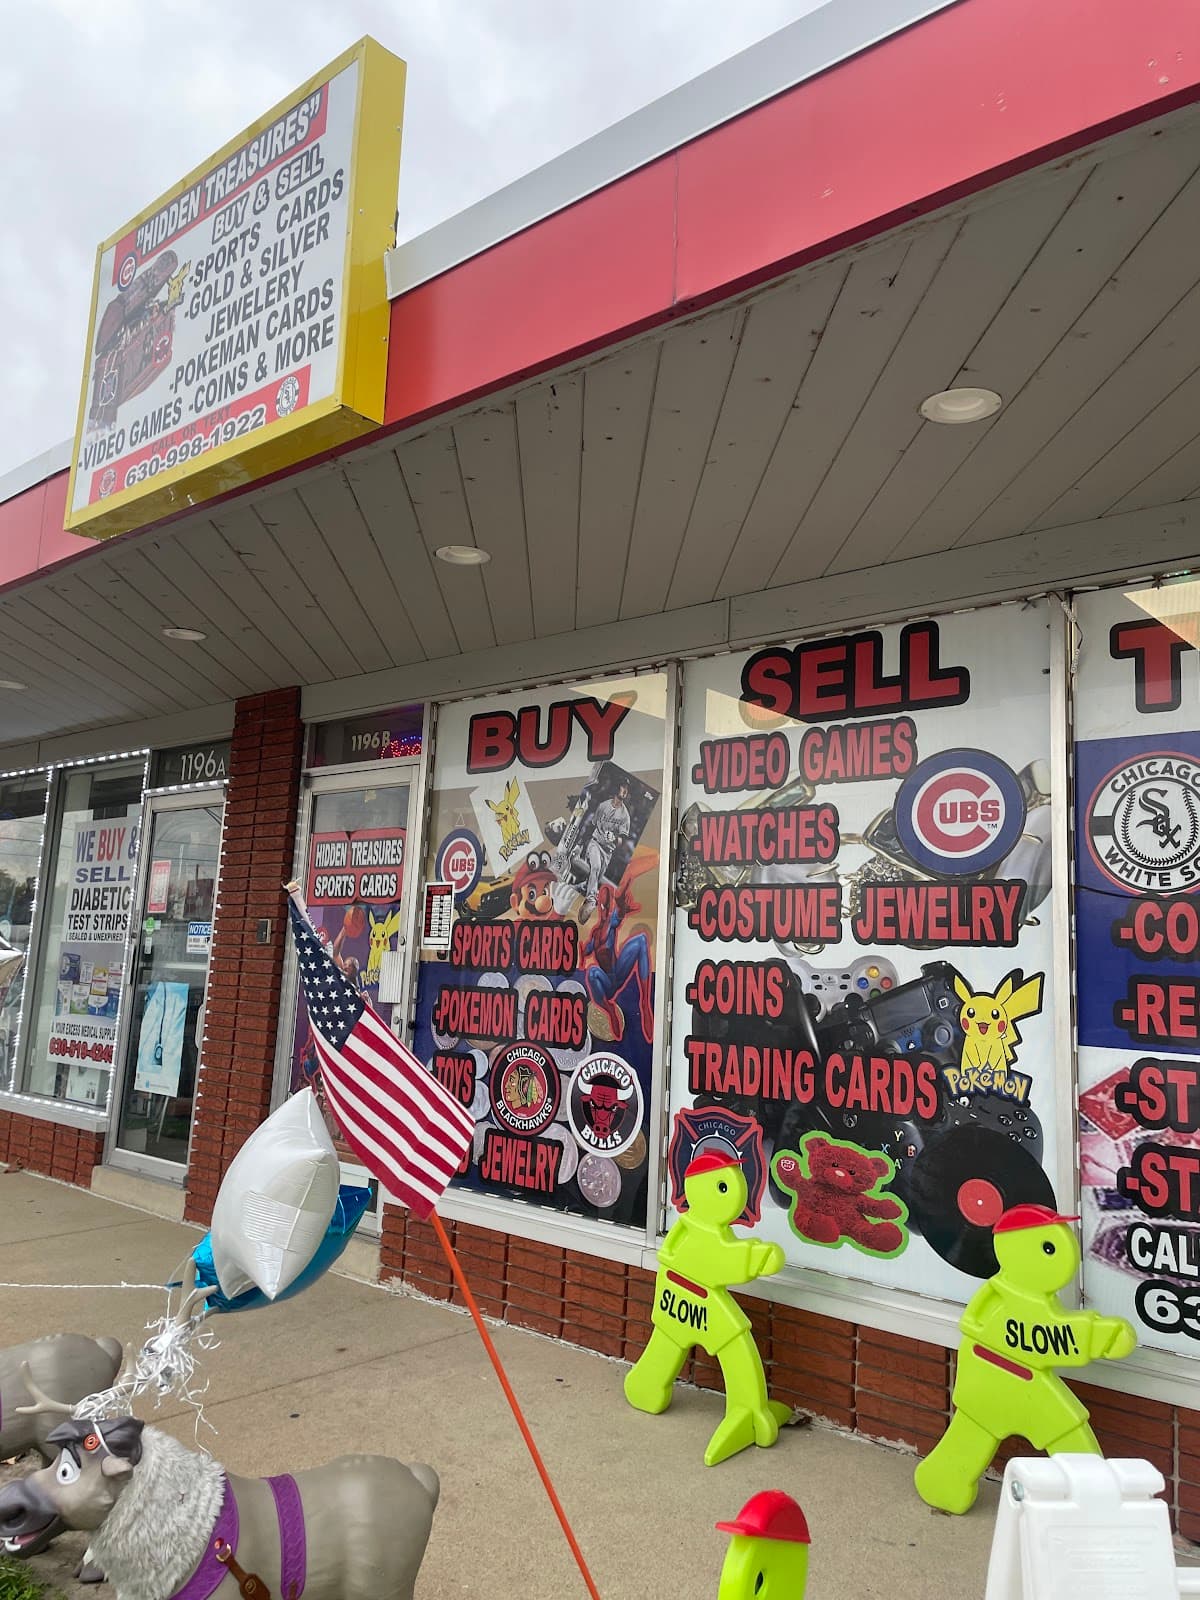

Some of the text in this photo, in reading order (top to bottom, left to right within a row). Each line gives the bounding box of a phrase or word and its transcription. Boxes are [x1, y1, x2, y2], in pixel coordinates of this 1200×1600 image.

[211, 143, 324, 244] BUY & SELL
[276, 168, 344, 234] CARDS
[240, 259, 252, 290] &
[259, 211, 330, 277] SILVER
[205, 260, 305, 343] JEWELERY
[266, 278, 334, 342] CARDS
[129, 397, 182, 448] GAMES
[254, 351, 267, 383] &
[275, 313, 335, 374] MORE
[182, 425, 197, 439] OR
[205, 405, 231, 429] TEXT
[124, 404, 266, 489] 630-998-1922
[739, 620, 970, 730] SELL
[467, 692, 637, 774] BUY
[802, 720, 914, 782] GAMES
[76, 830, 96, 862] WE
[97, 827, 126, 861] BUY
[315, 839, 403, 868] HIDDEN TREASURES
[1105, 846, 1172, 887] WHITE
[75, 866, 130, 883] SELL
[314, 875, 355, 898] SPORTS
[359, 873, 398, 898] CARDS
[71, 886, 131, 911] DIABETIC
[856, 885, 1022, 942] JEWELRY
[68, 913, 128, 931] TEST STRIPS
[189, 924, 212, 935] NOTICE
[451, 924, 575, 972] SPORTS CARDS
[527, 995, 585, 1046] CARDS
[506, 1046, 547, 1067] CHICAGO
[581, 1059, 631, 1088] CHICAGO
[687, 1040, 938, 1120] TRADING CARDS
[580, 1124, 622, 1149] BULLS
[698, 1120, 737, 1137] CHICAGO
[482, 1134, 560, 1193] JEWELRY
[660, 1289, 709, 1332] SLOW!
[1005, 1319, 1080, 1356] SLOW!
